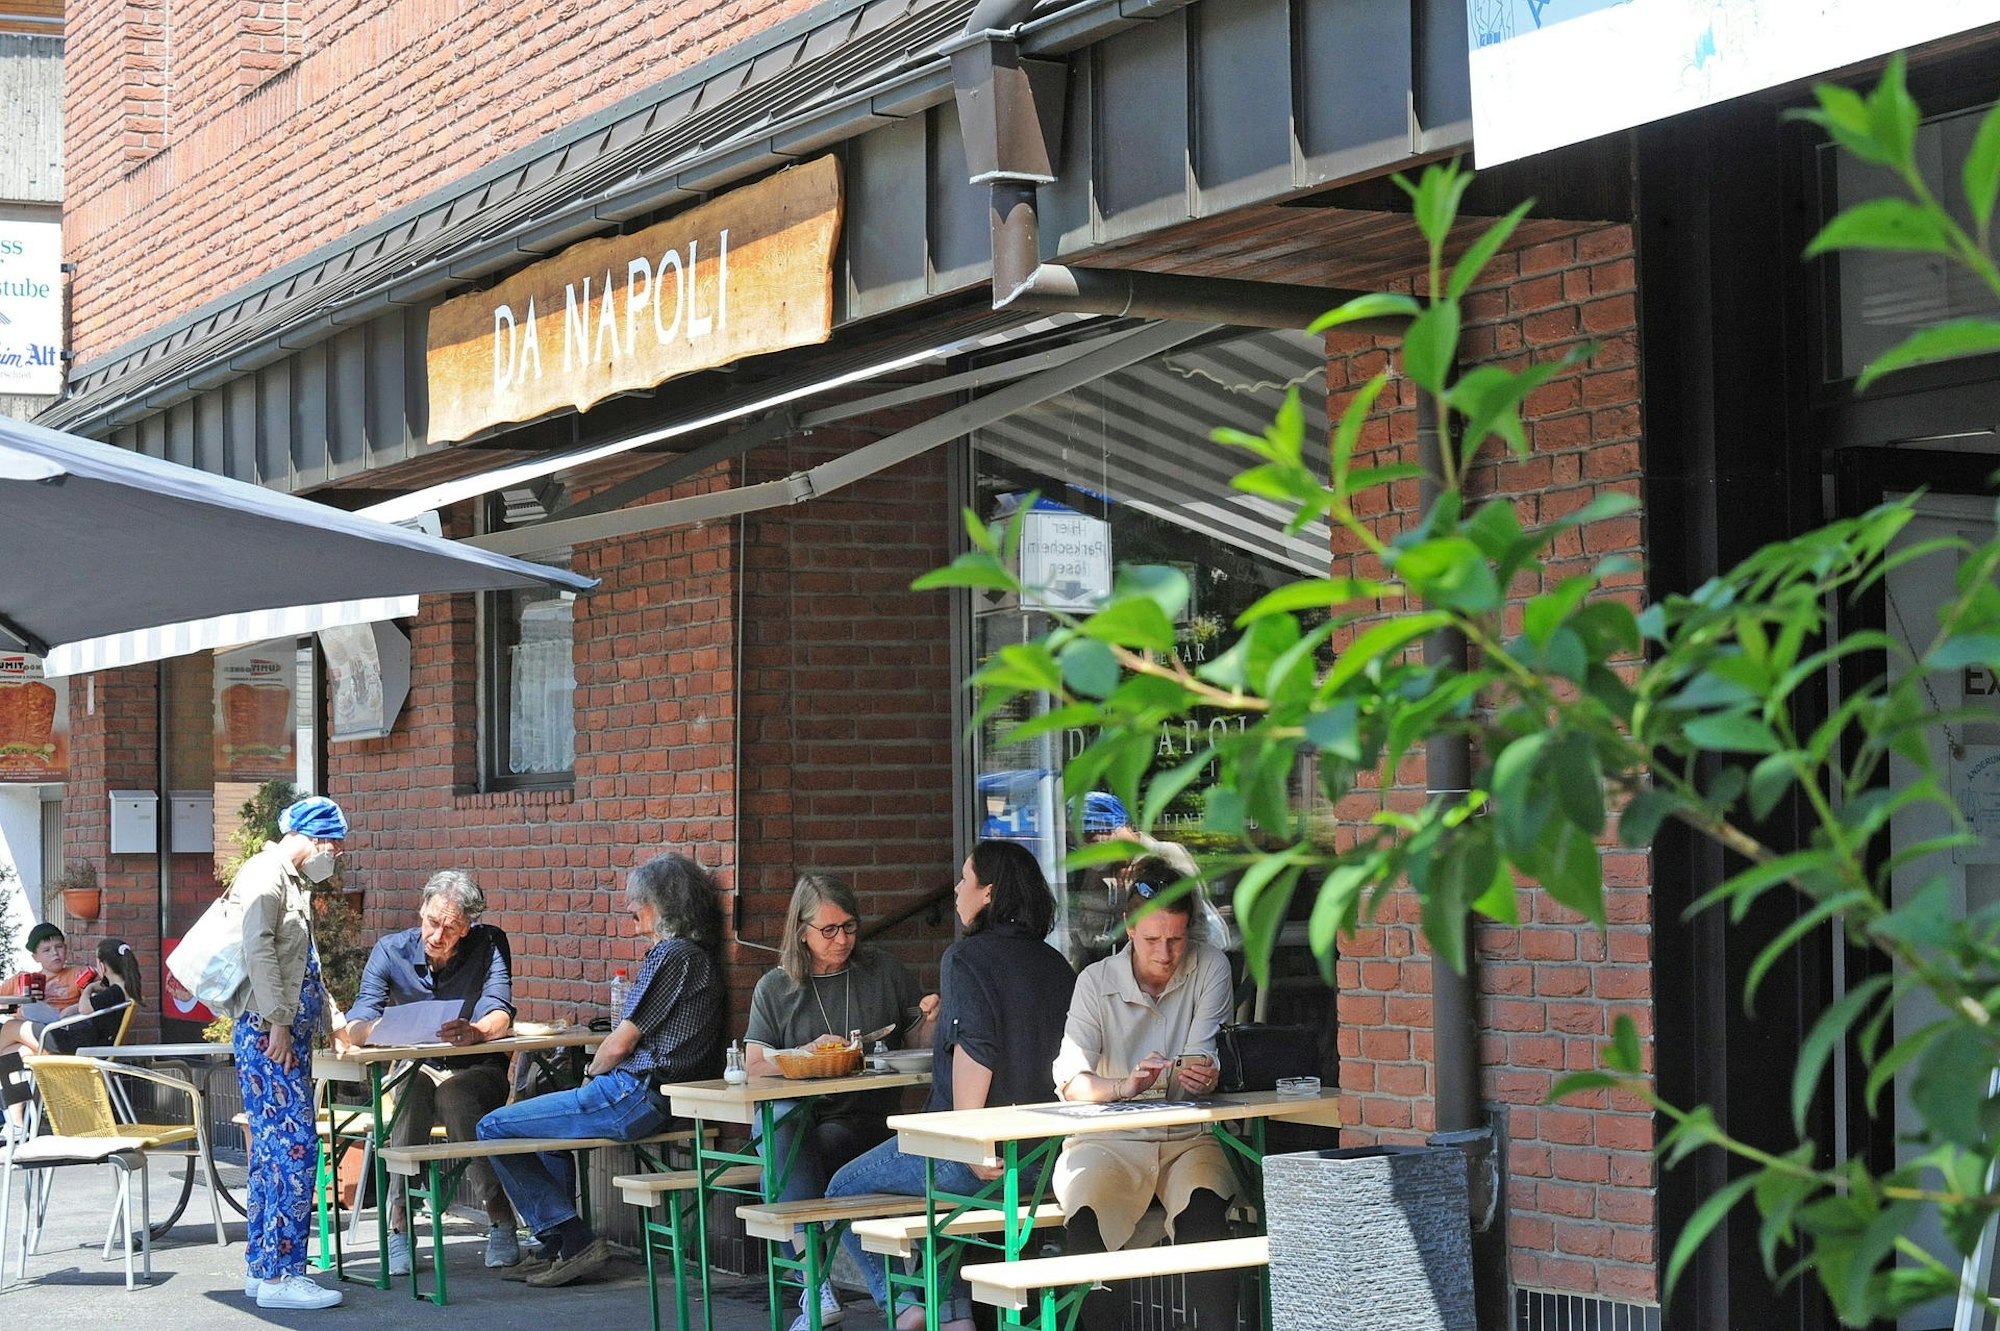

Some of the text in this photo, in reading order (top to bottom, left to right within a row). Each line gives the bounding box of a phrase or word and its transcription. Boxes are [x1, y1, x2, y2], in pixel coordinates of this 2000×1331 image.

[0, 278, 50, 299] tube
[493, 228, 729, 396] DA NAPOLI
[25, 342, 56, 366] Alt
